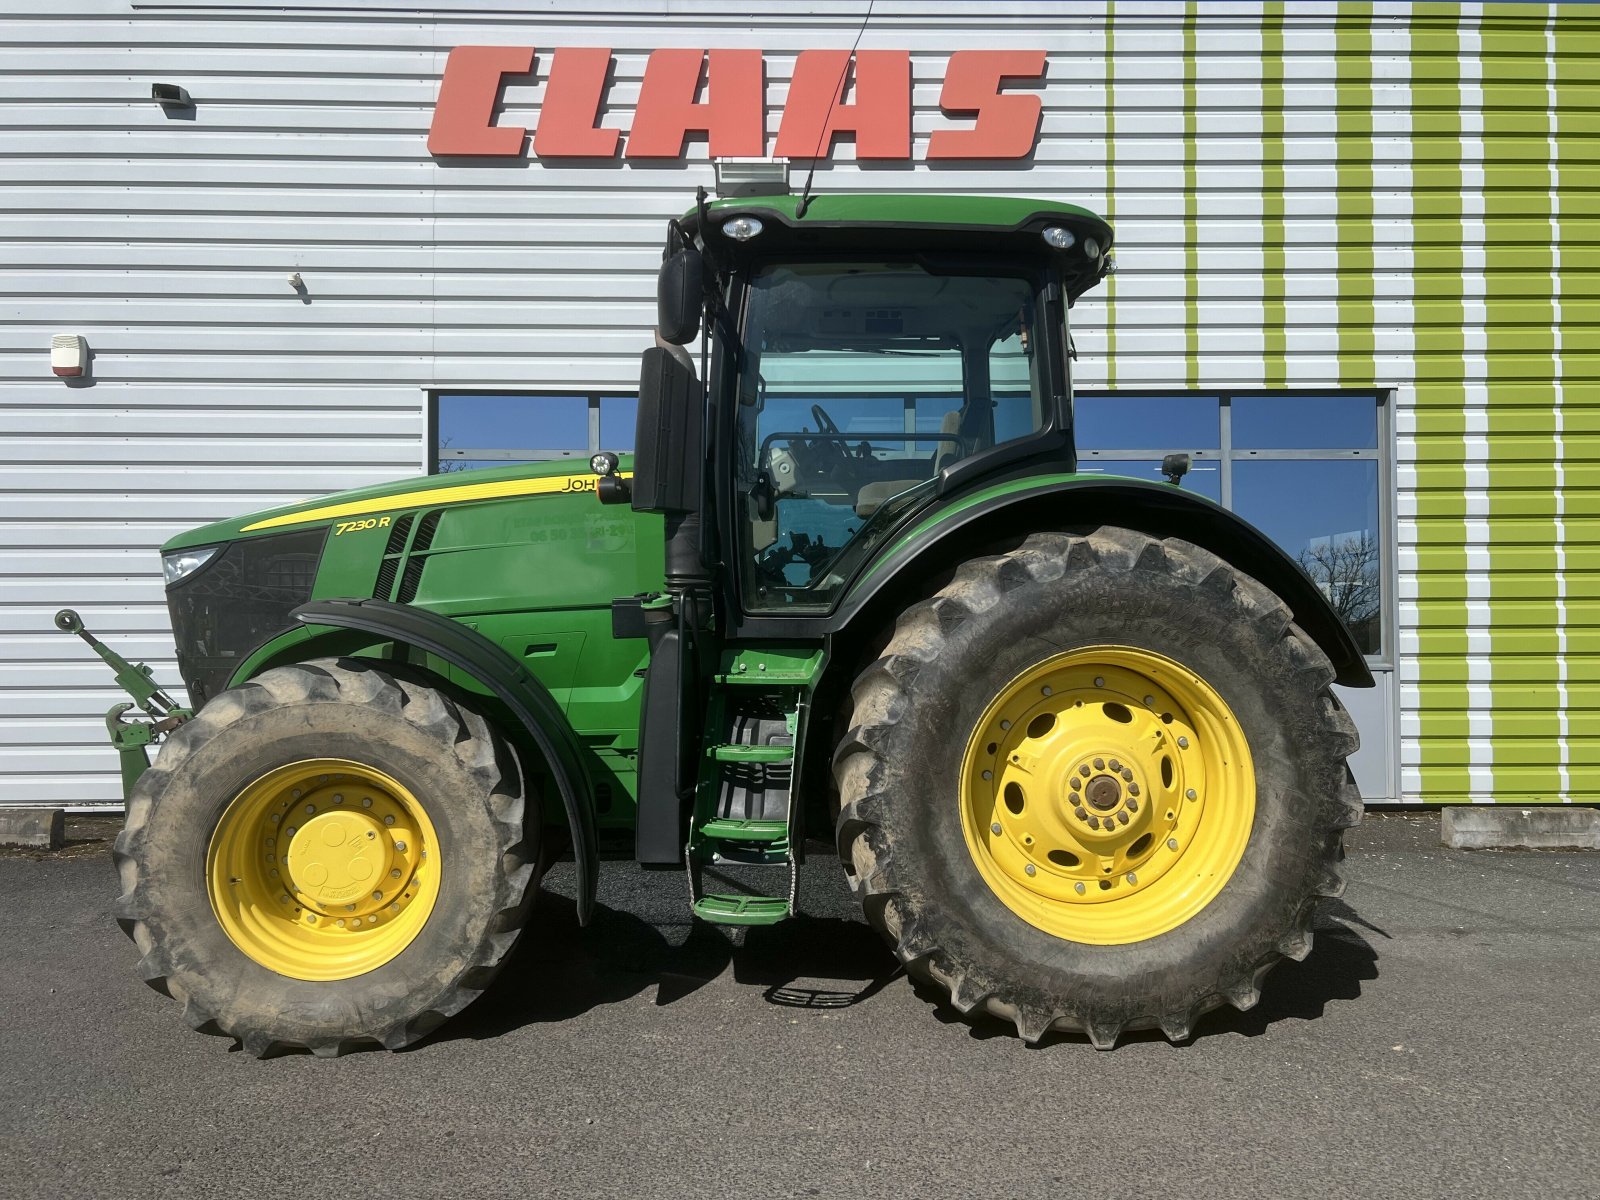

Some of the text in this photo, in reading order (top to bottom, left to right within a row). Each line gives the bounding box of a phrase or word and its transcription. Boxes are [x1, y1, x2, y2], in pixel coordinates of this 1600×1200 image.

[427, 45, 1047, 160] CLAAS
[561, 478, 596, 492] JOH
[335, 515, 391, 536] 7230 R
